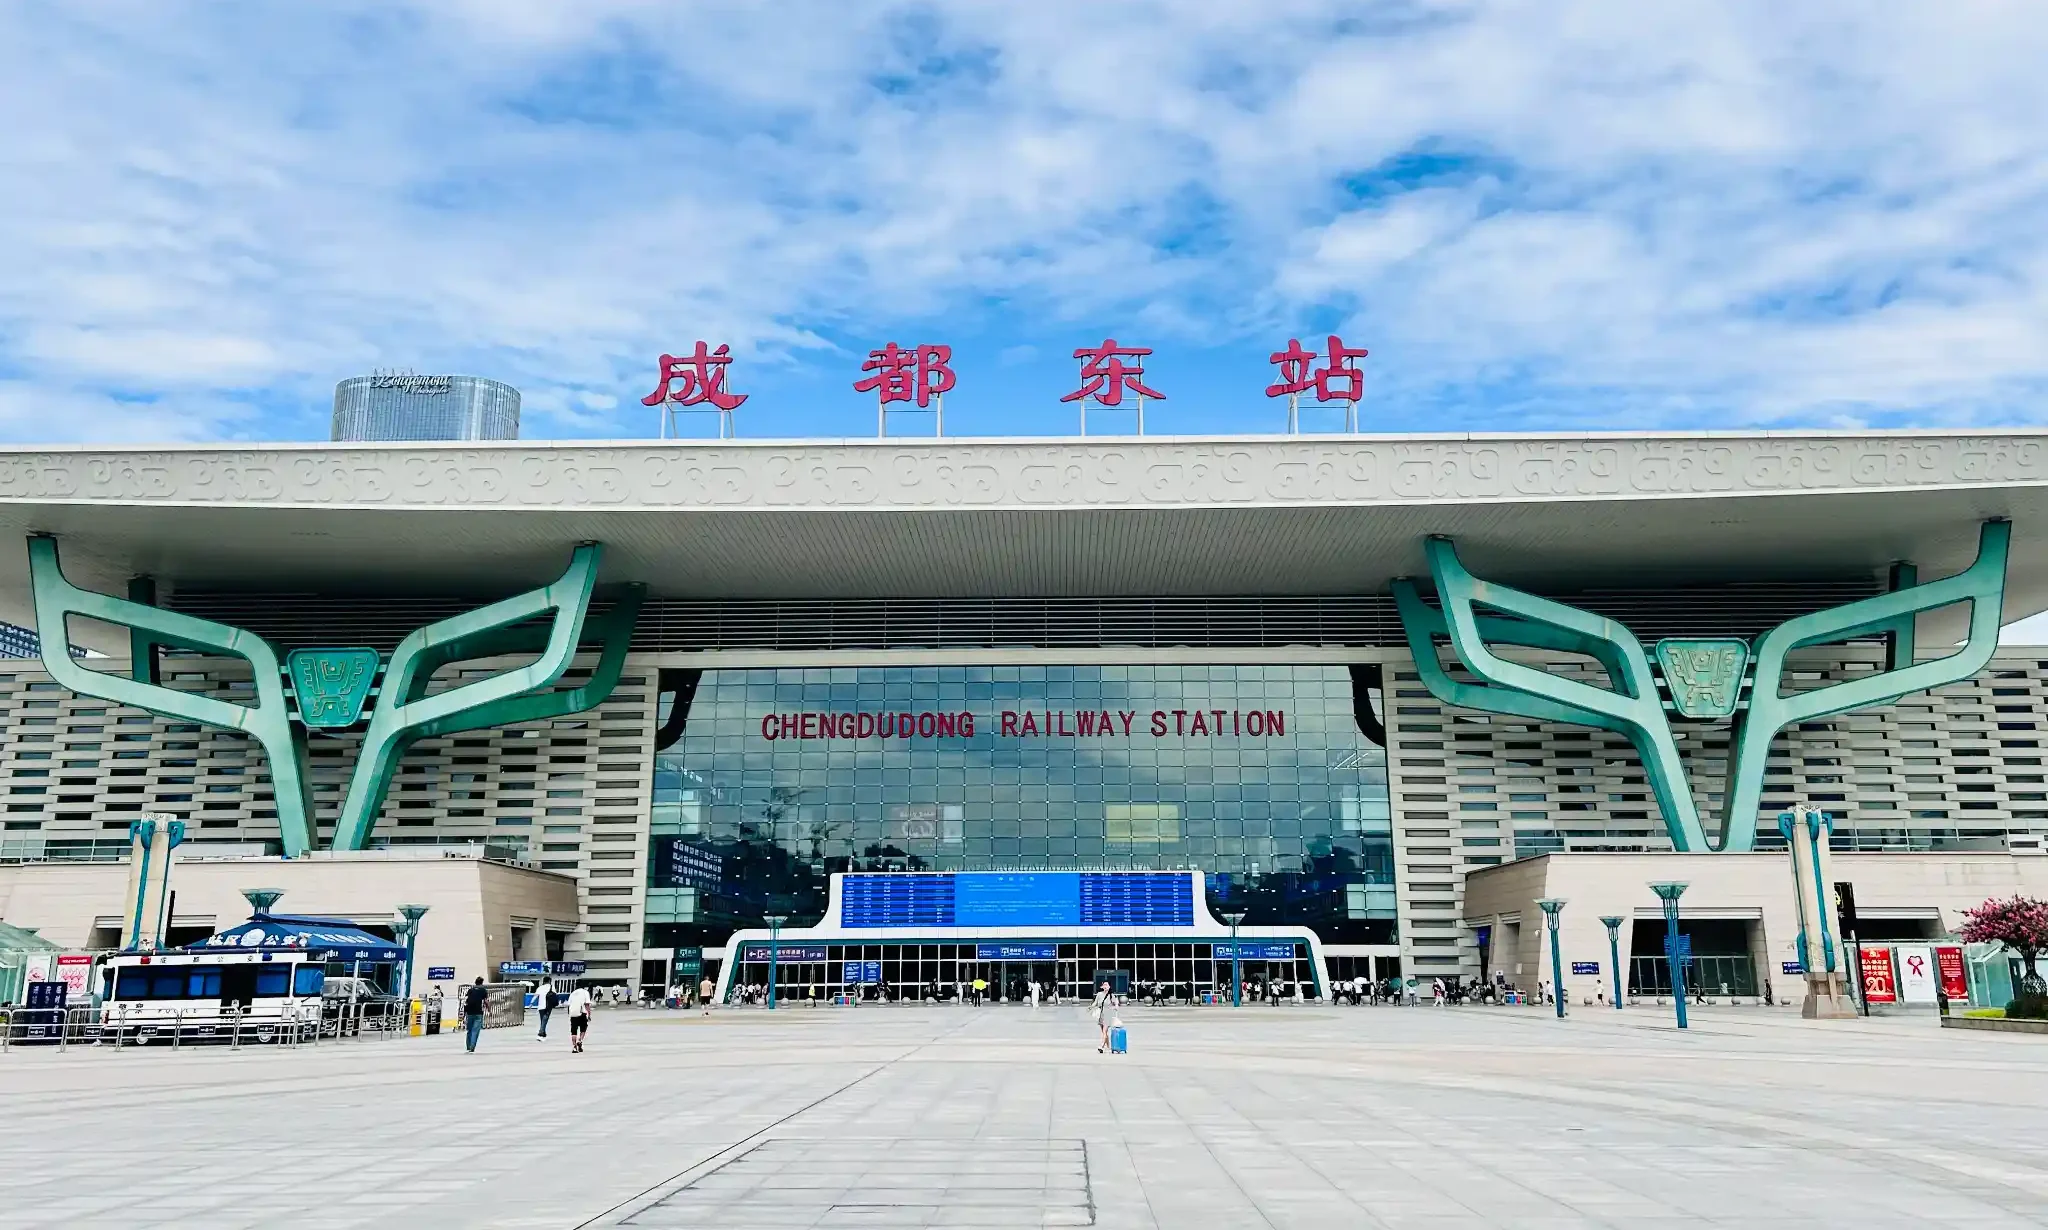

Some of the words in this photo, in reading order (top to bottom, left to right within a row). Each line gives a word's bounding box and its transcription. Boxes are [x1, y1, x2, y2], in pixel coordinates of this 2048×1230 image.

[641, 336, 1369, 409] 成都东站
[762, 712, 975, 740] CHENGDUDONG
[1001, 711, 1136, 735] RAILWAY
[1152, 710, 1286, 736] STATION
